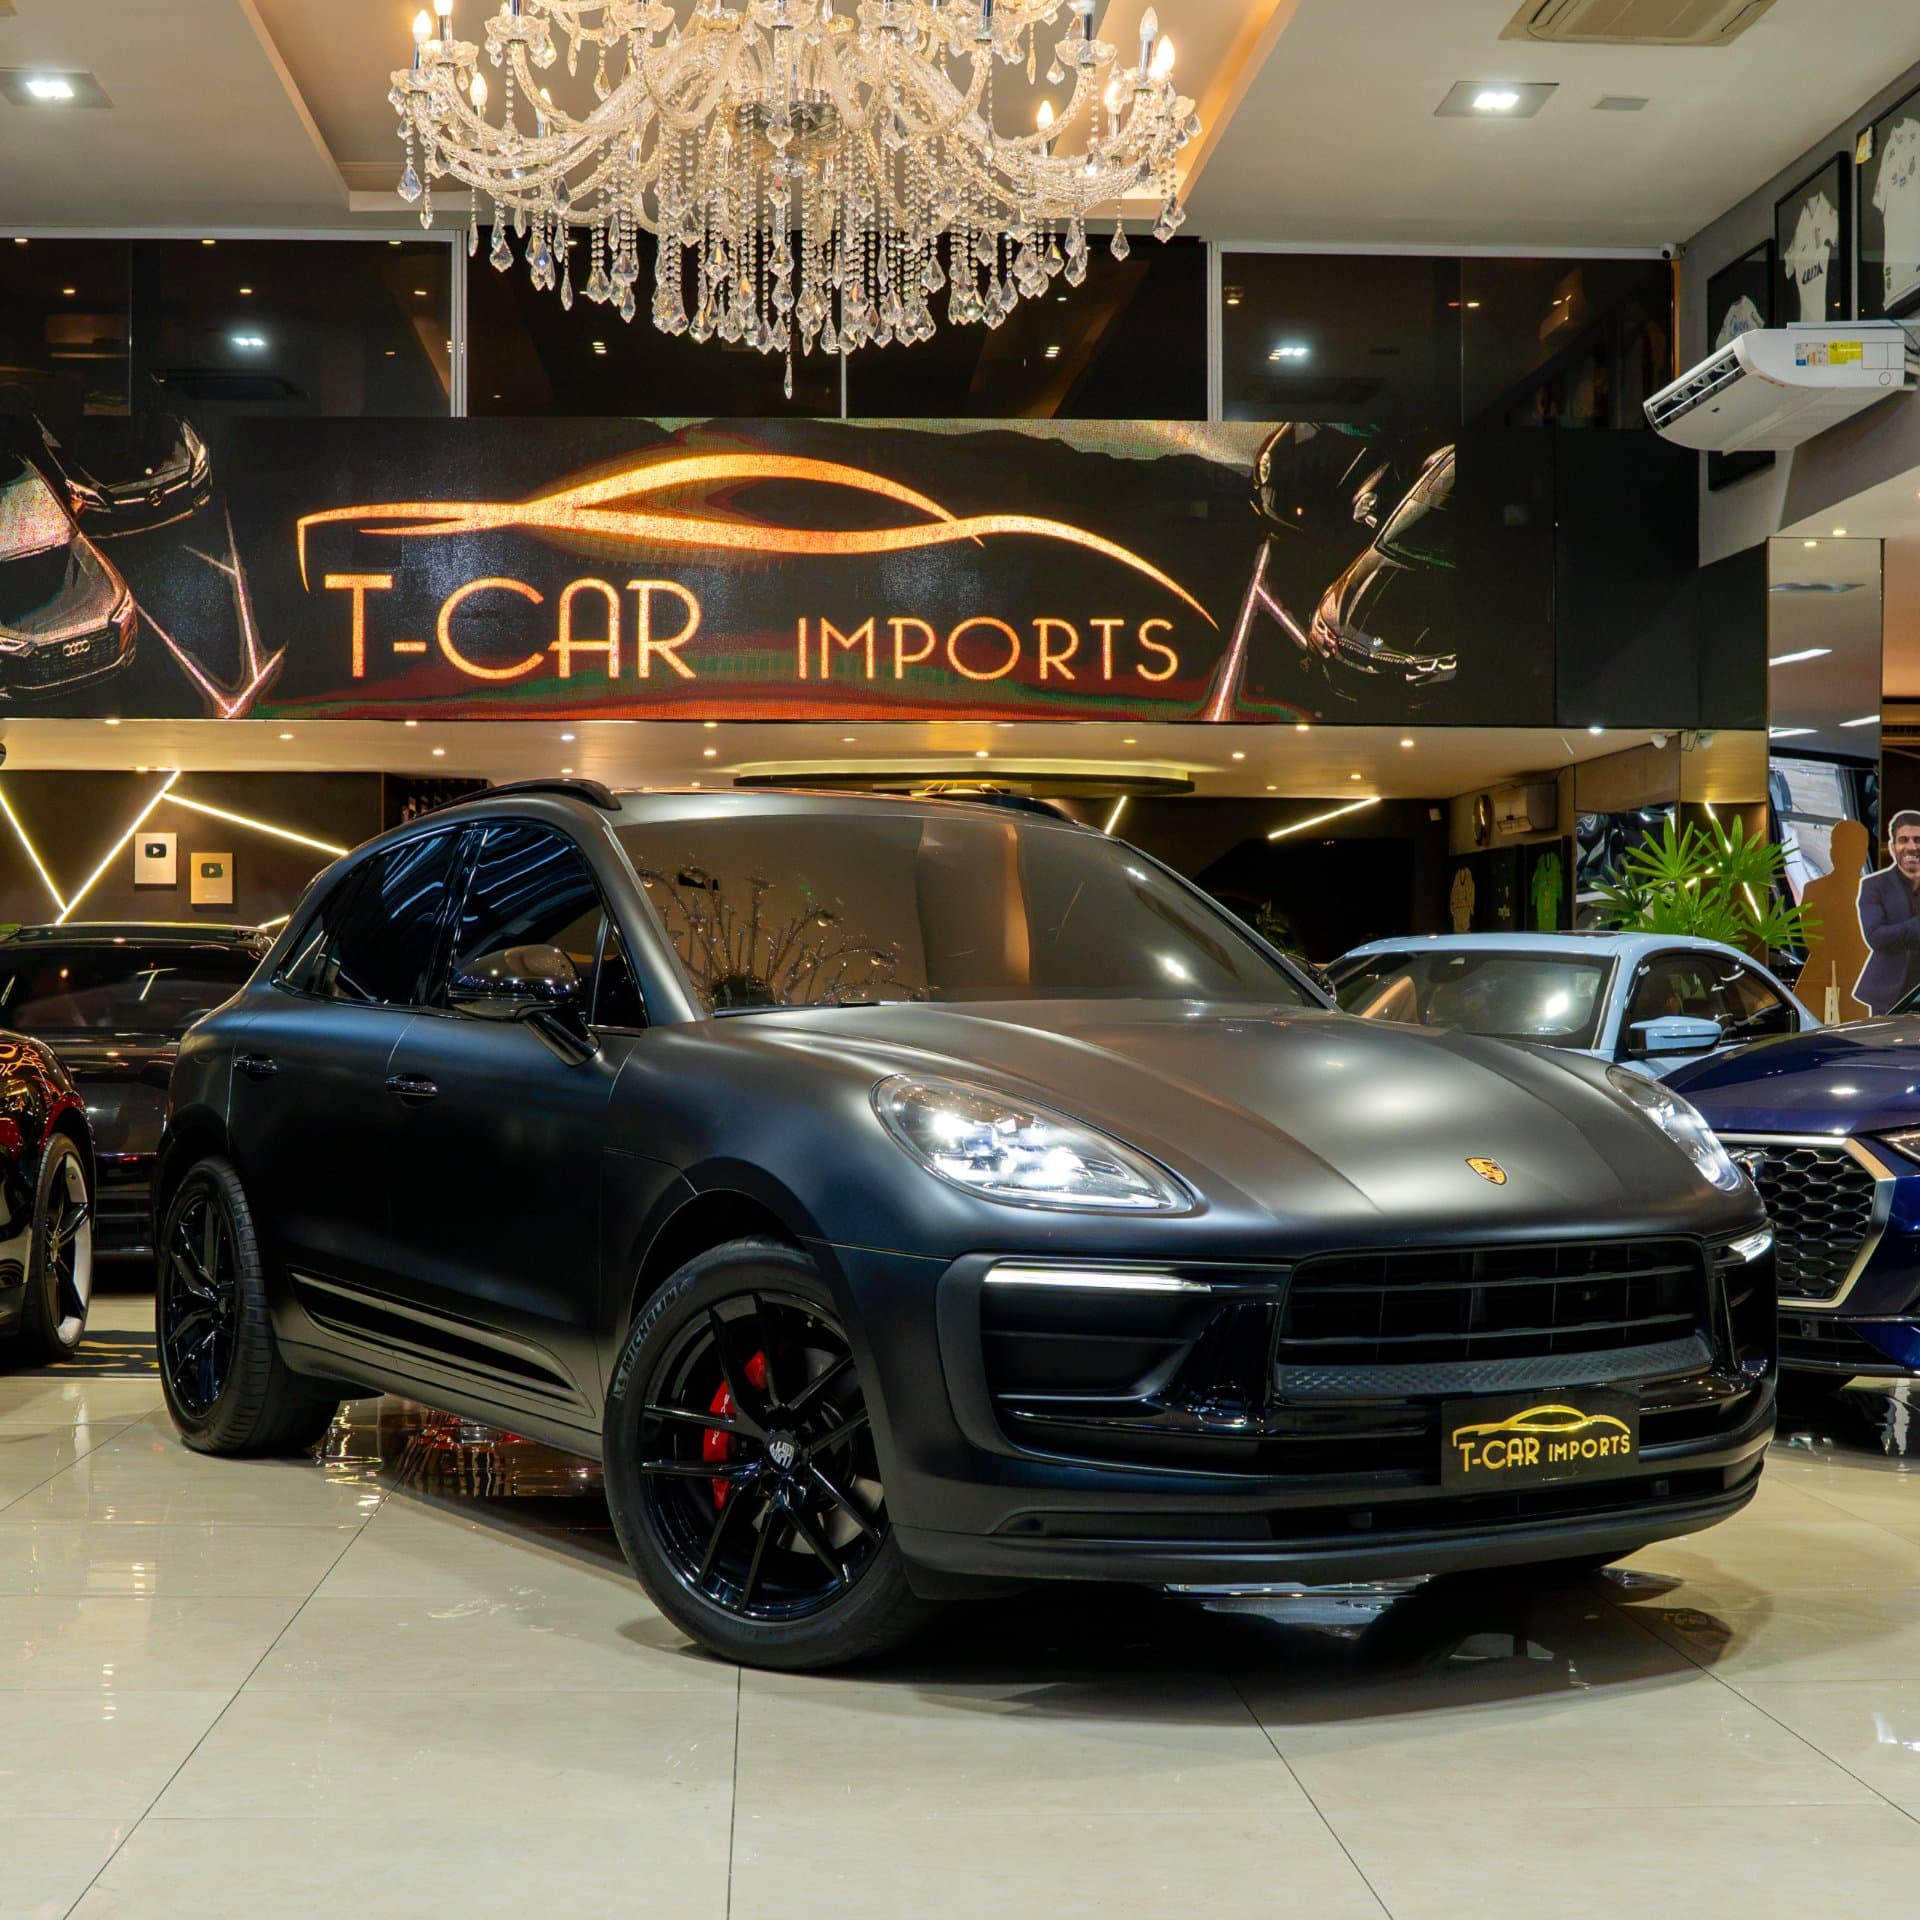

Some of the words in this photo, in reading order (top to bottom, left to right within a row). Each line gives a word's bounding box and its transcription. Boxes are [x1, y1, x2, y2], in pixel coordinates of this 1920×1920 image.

[324, 574, 701, 680] T-CAR
[797, 616, 1179, 681] IMPORTS
[1459, 1437, 1540, 1473] T-CAR
[1548, 1434, 1631, 1462] IMPORTS
